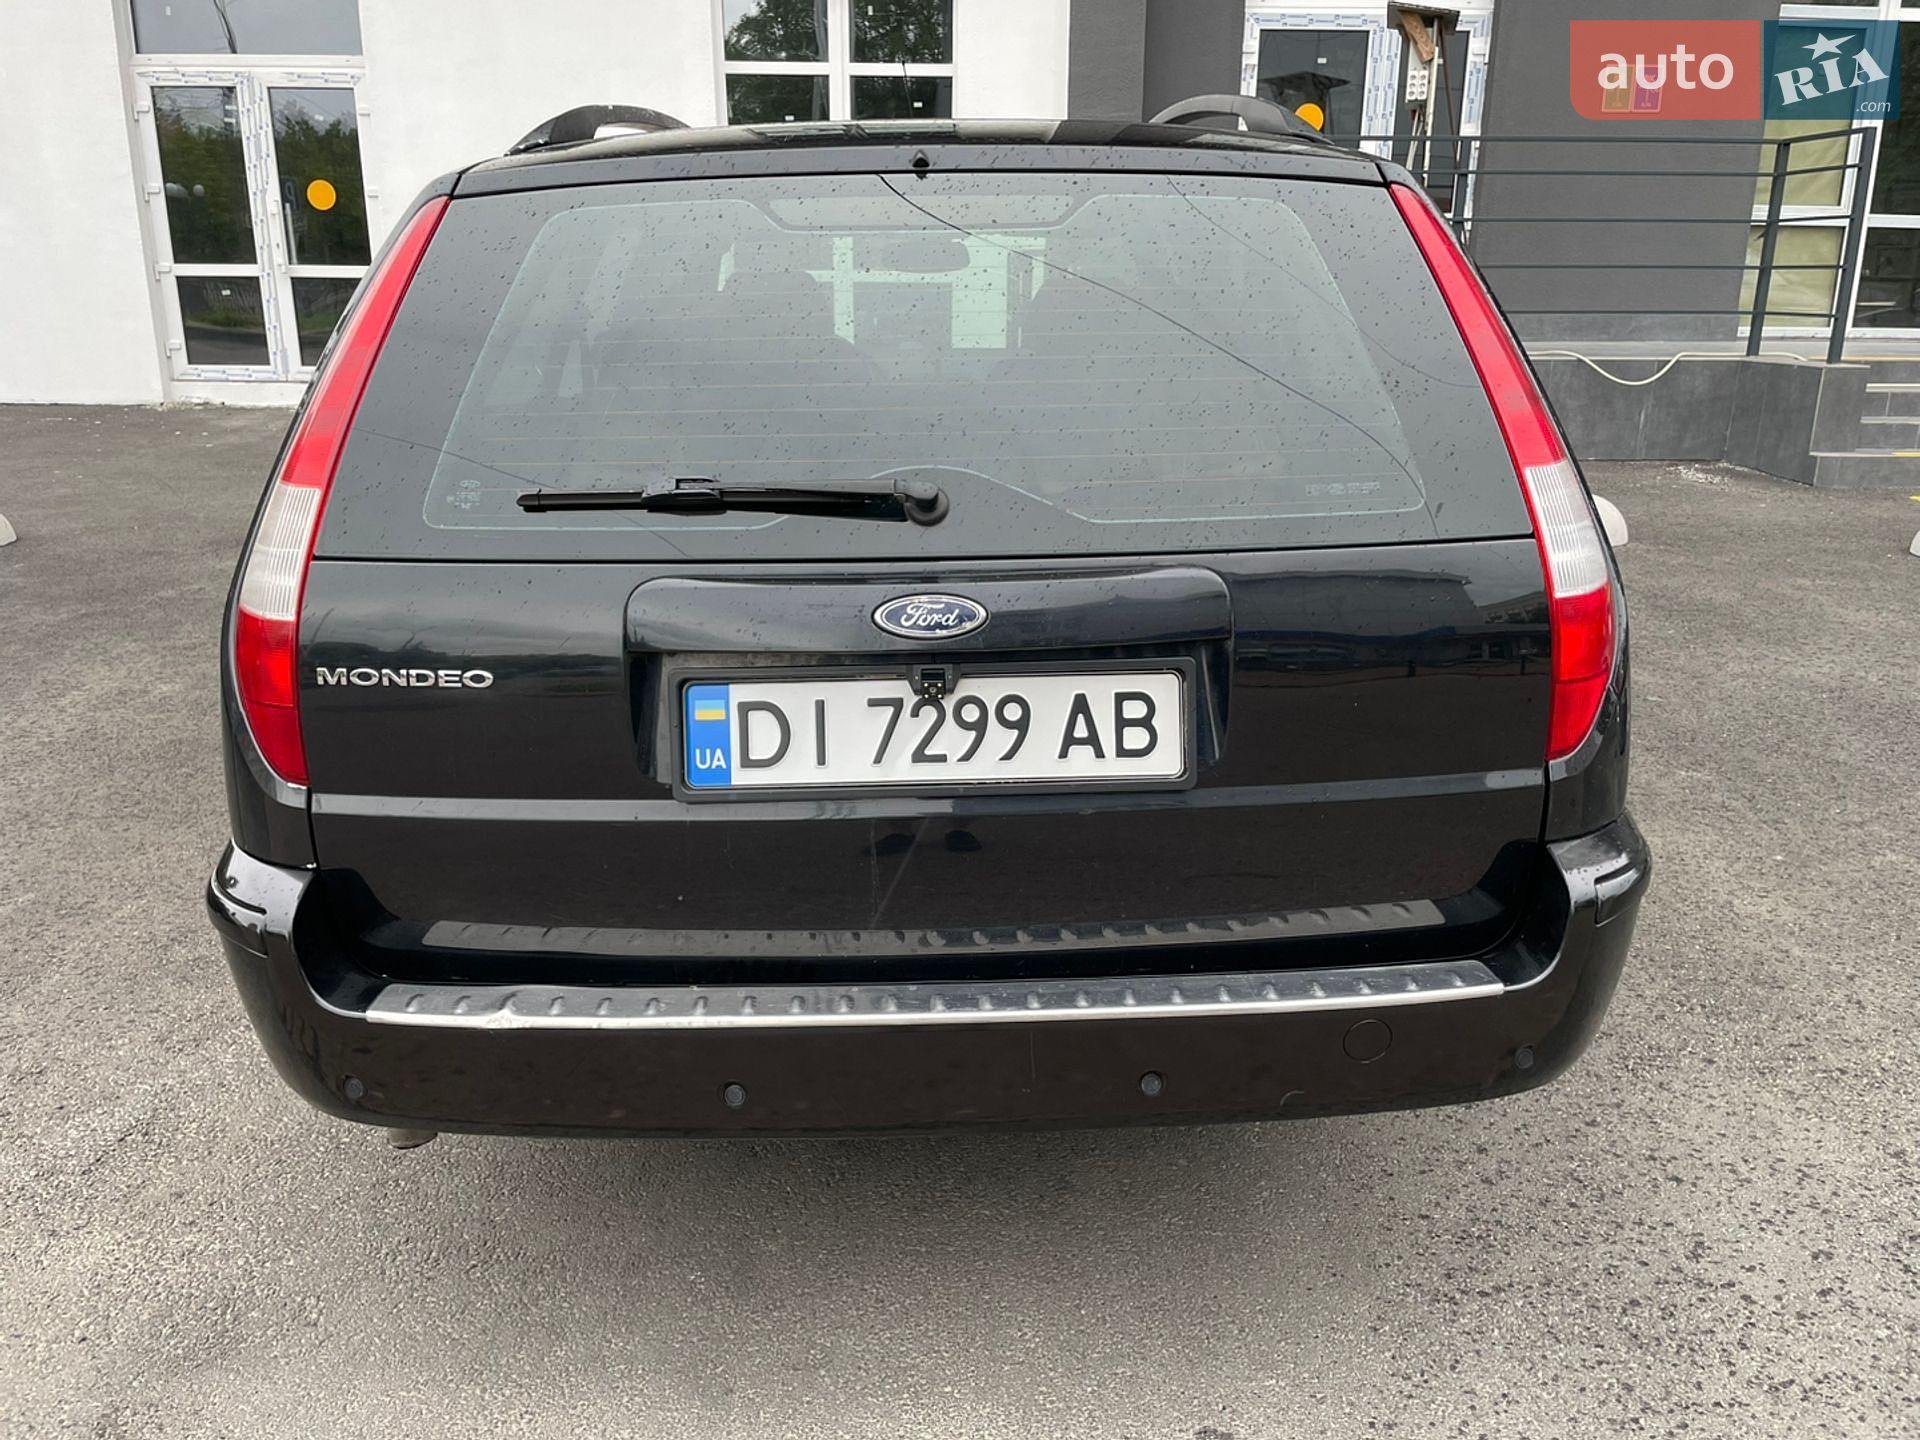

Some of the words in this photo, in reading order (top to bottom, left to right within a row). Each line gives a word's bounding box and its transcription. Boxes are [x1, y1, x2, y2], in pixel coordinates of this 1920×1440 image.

[901, 602, 959, 627] Ford
[316, 667, 493, 688] MONDEO
[737, 699, 828, 769] DI
[866, 693, 1032, 766] 7299
[1057, 692, 1159, 762] AB
[695, 748, 727, 770] UA
